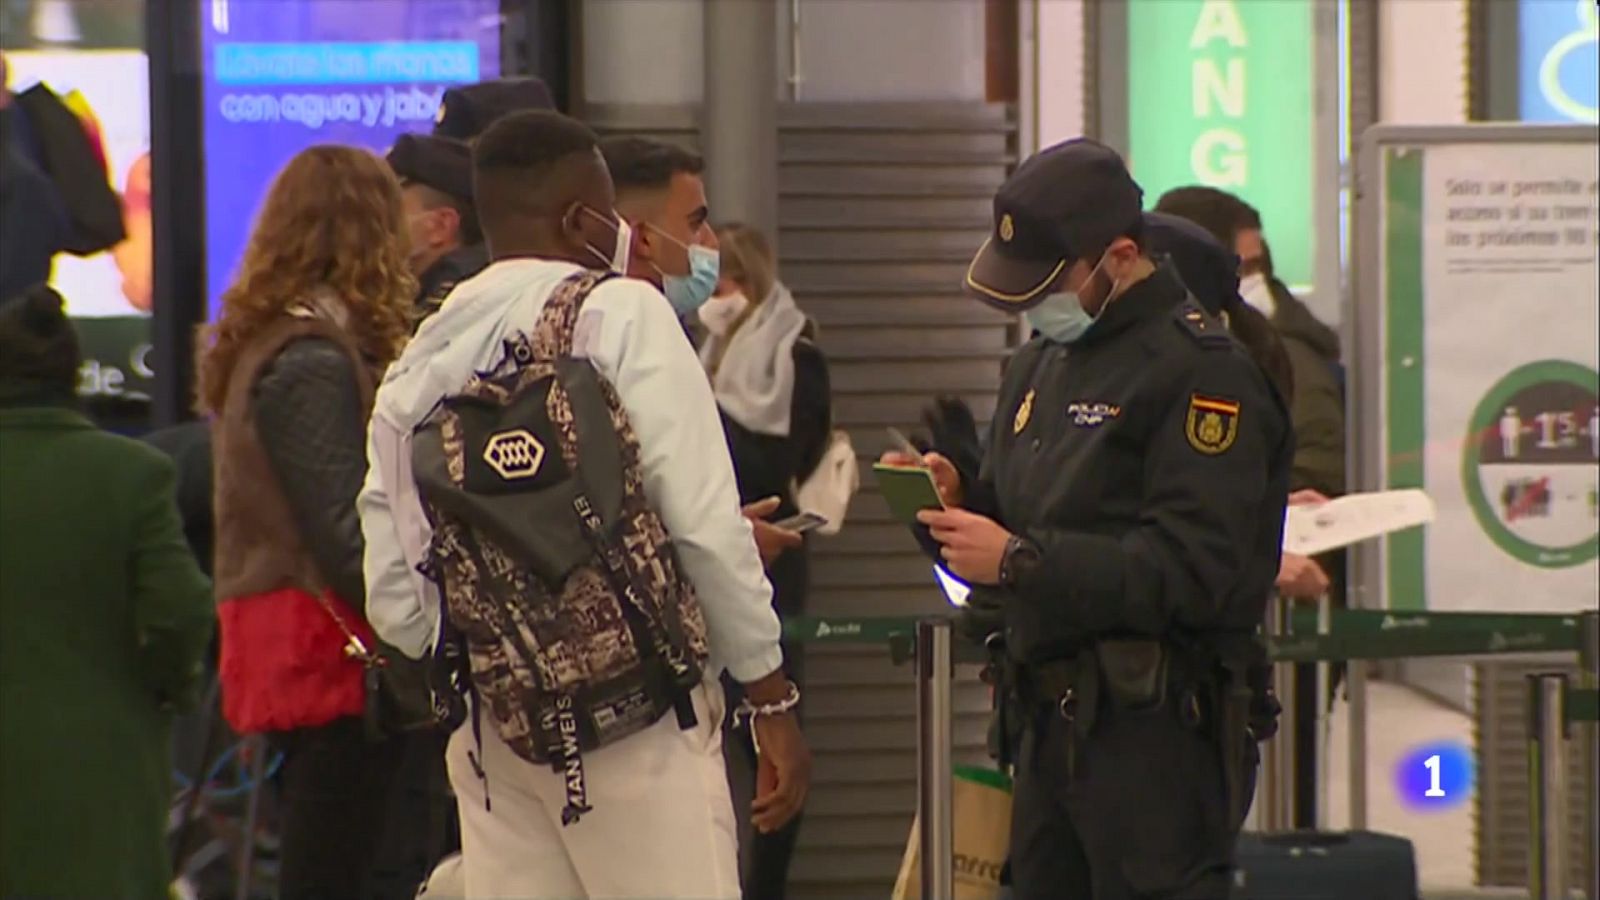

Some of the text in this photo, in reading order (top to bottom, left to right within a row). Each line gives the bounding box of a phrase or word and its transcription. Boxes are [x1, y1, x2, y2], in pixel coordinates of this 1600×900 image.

[219, 94, 280, 122] con
[281, 93, 361, 128] agua
[361, 96, 384, 127] y
